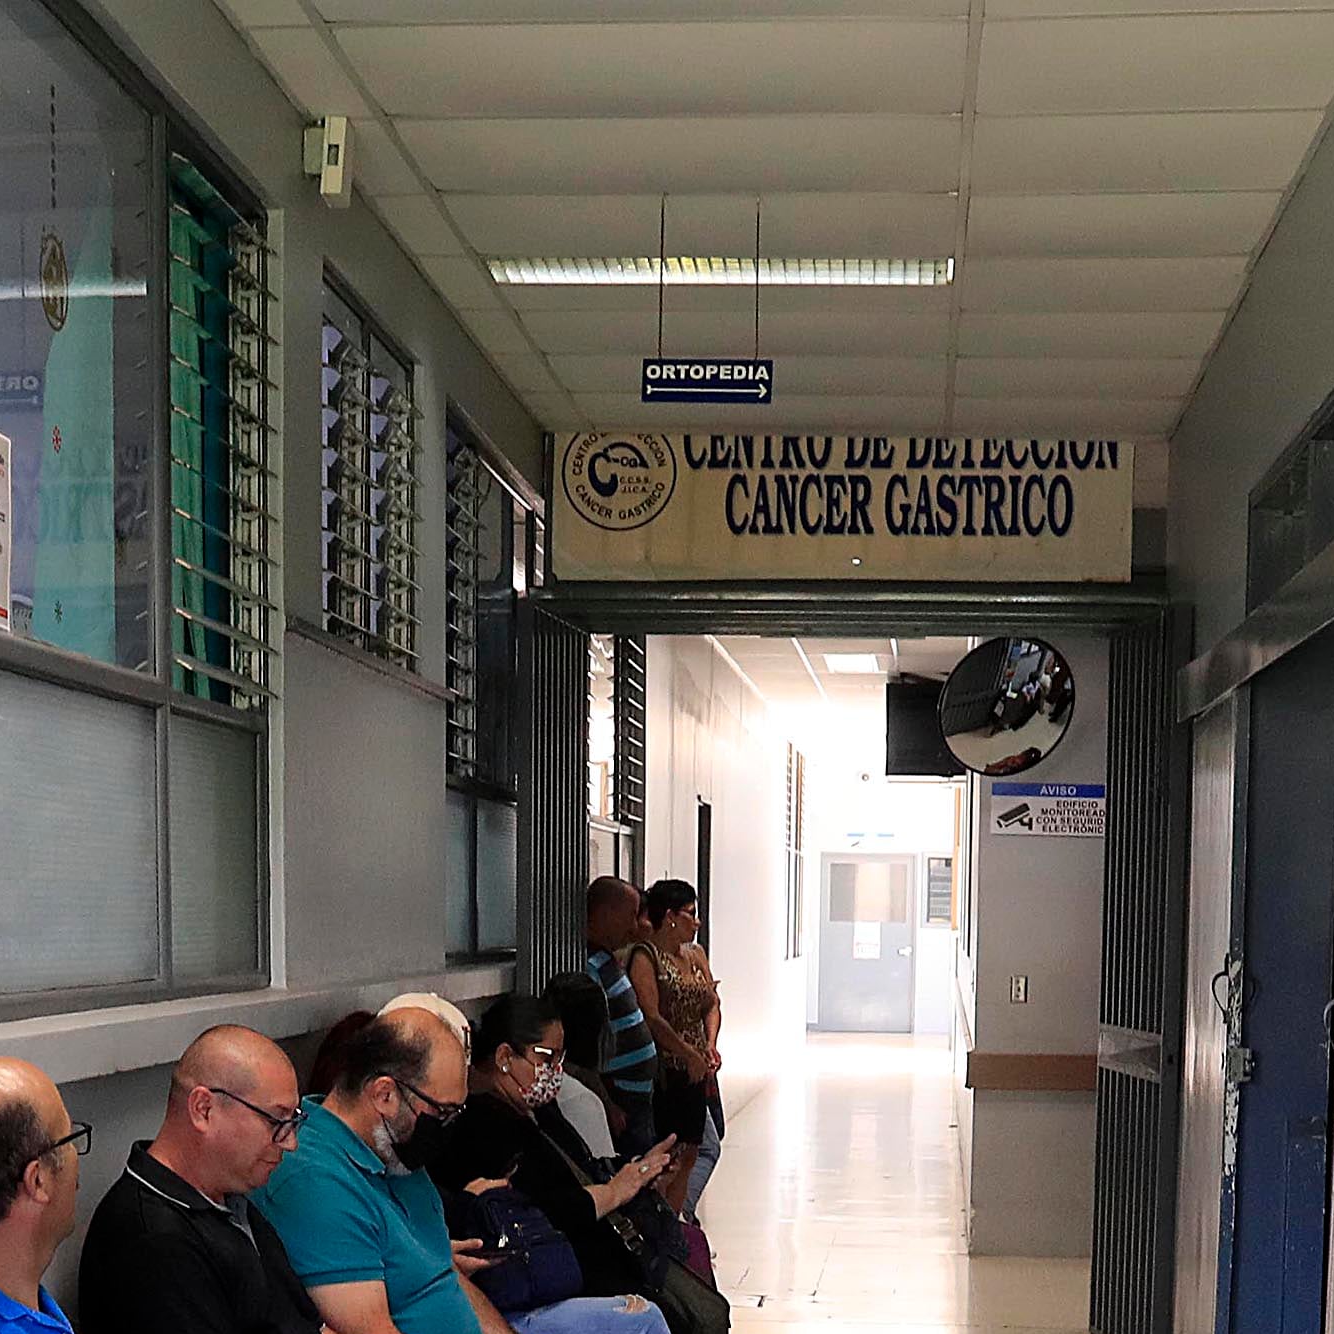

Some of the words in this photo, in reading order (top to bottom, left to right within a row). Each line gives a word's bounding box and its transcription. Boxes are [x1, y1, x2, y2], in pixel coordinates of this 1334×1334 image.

[646, 364, 770, 381] ORTOPEDIA
[572, 433, 598, 476] CENTRO
[684, 435, 832, 470] CENTRO
[845, 435, 894, 470] DE
[906, 437, 1119, 471] DETECCION
[575, 484, 613, 519] CANCER
[618, 482, 665, 520] GASTRICO
[726, 474, 873, 535] CANCER
[884, 474, 1074, 536] GASTRICO
[1040, 785, 1077, 796] AVISO
[1041, 808, 1105, 817] MONITOREAD
[1056, 800, 1098, 809] EDIFICIO
[1036, 816, 1057, 824] CON
[1060, 817, 1104, 826] SEGURID
